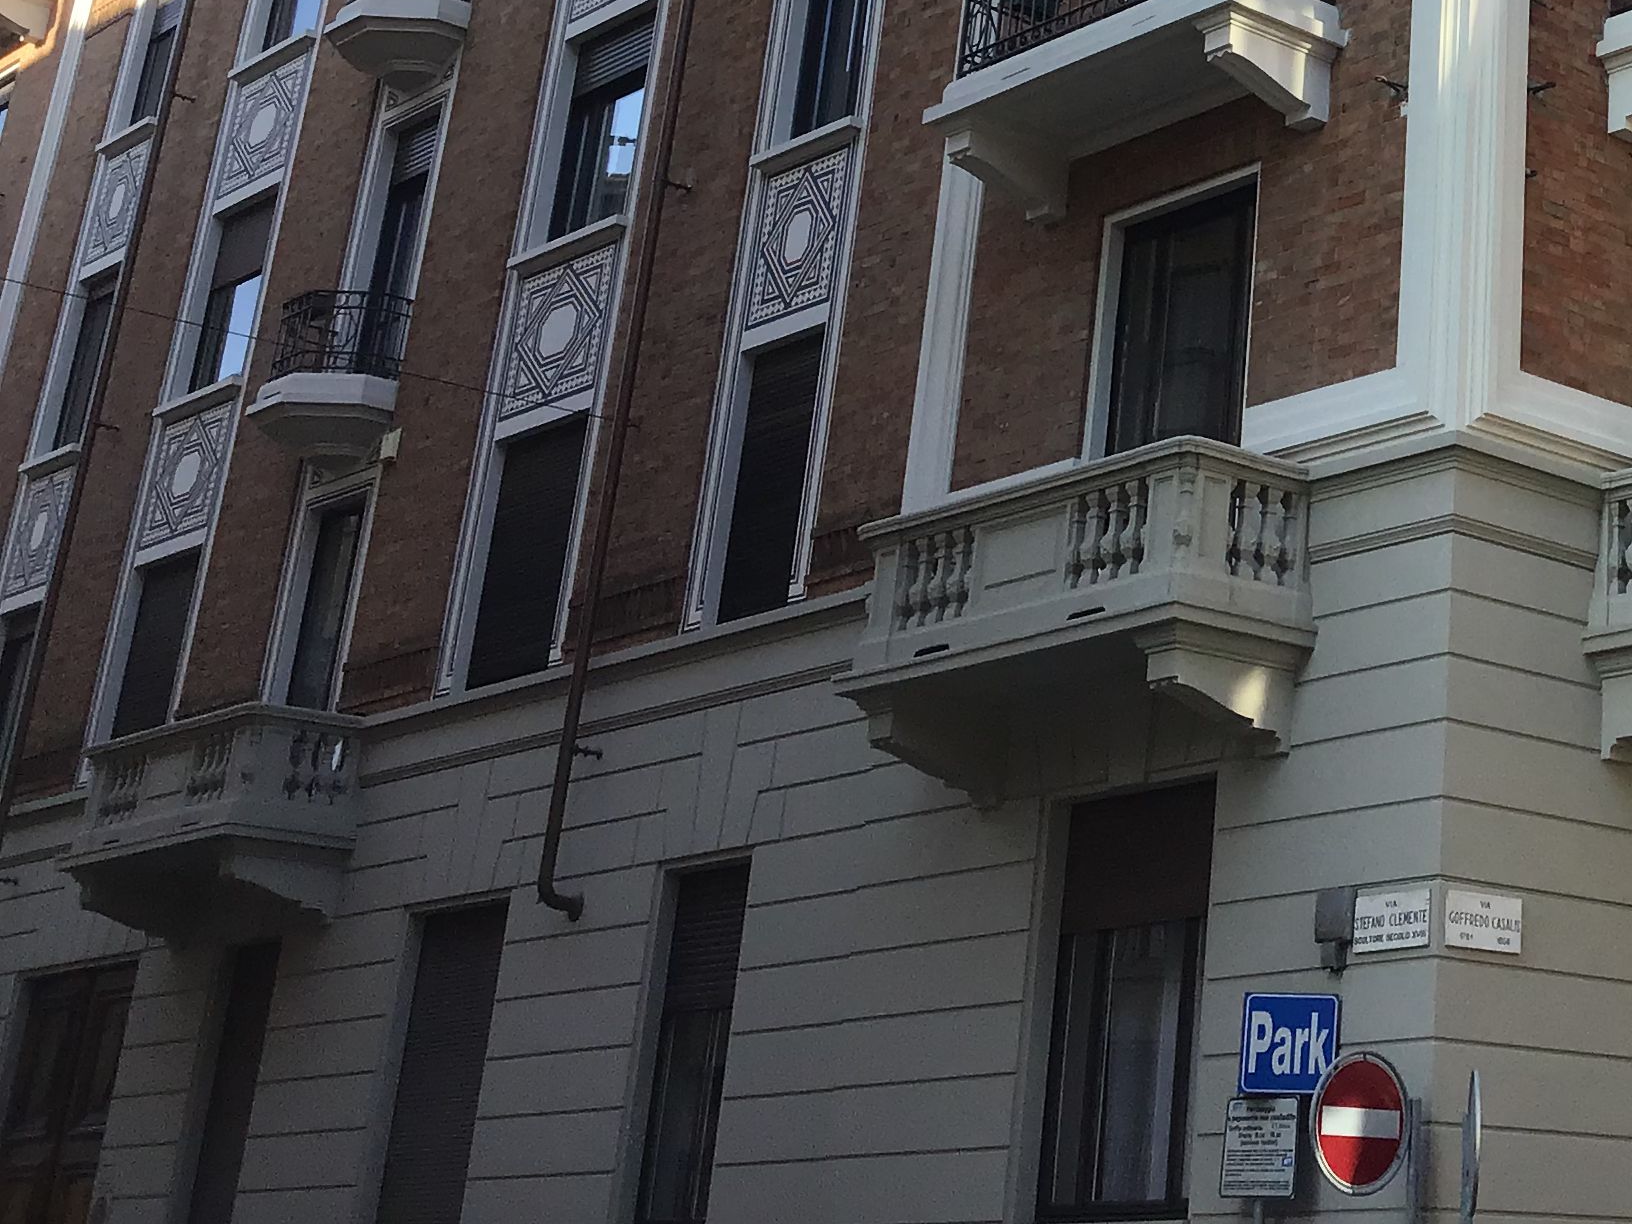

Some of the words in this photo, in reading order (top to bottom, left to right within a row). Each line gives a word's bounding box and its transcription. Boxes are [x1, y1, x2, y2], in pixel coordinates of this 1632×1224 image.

[1385, 900, 1398, 908] VIA
[1480, 900, 1491, 909] VIA
[1354, 914, 1385, 930] STEFANO
[1389, 909, 1427, 926] CLEMENTE
[1449, 910, 1489, 928] GOFFREDO
[1247, 1010, 1330, 1076] Park
